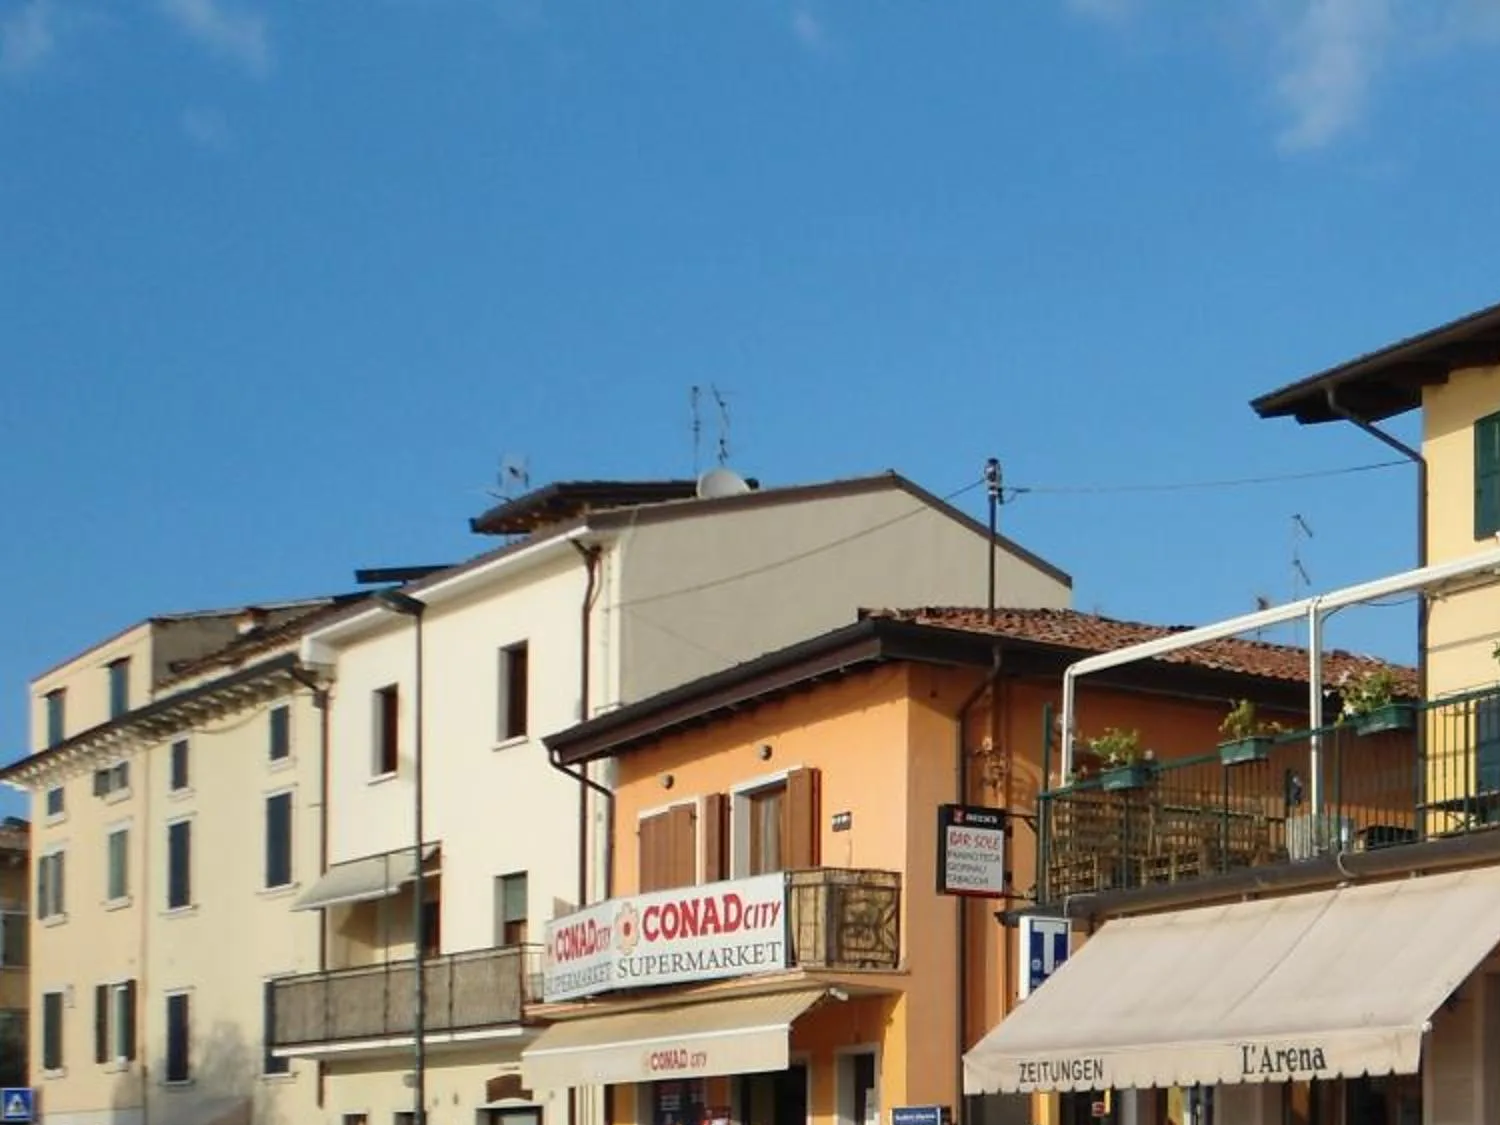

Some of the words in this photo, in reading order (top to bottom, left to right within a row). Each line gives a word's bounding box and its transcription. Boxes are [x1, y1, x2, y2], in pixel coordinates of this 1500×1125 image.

[616, 941, 781, 979] SUPERMARKET
[1019, 1059, 1103, 1083] ZEITUNGEN
[1242, 1045, 1327, 1075] L'Arena
